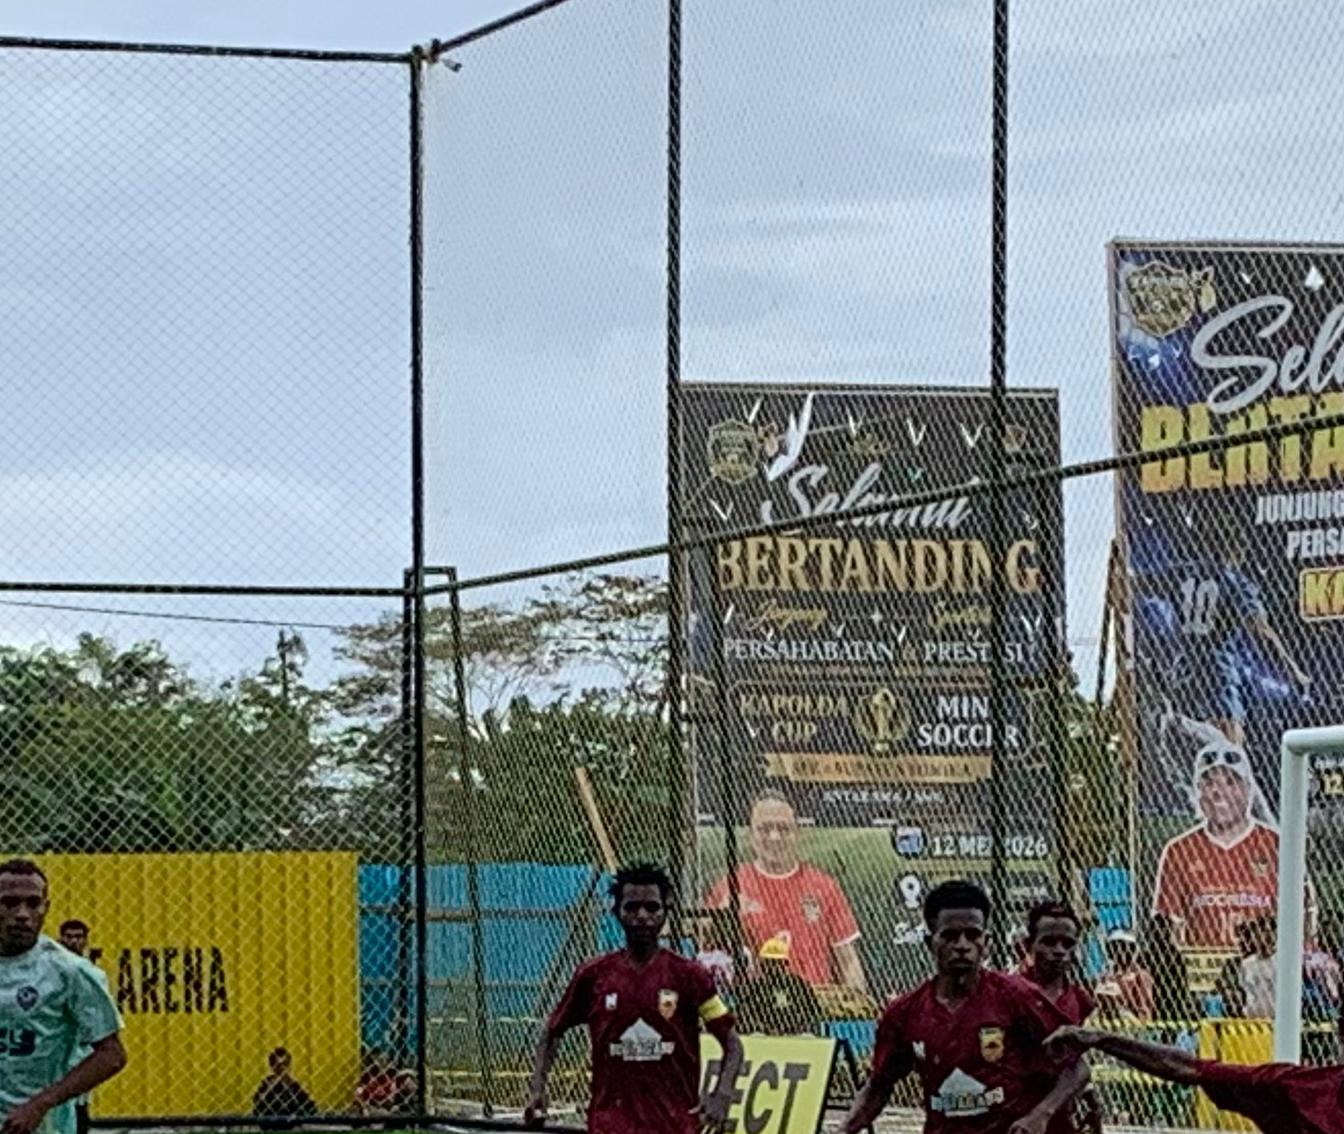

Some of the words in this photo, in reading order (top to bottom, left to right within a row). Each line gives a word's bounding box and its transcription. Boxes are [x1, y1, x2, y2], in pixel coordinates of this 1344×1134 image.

[925, 640, 1026, 662] PRESTSI
[937, 697, 990, 719] MIN
[118, 948, 229, 1014] ARENA
